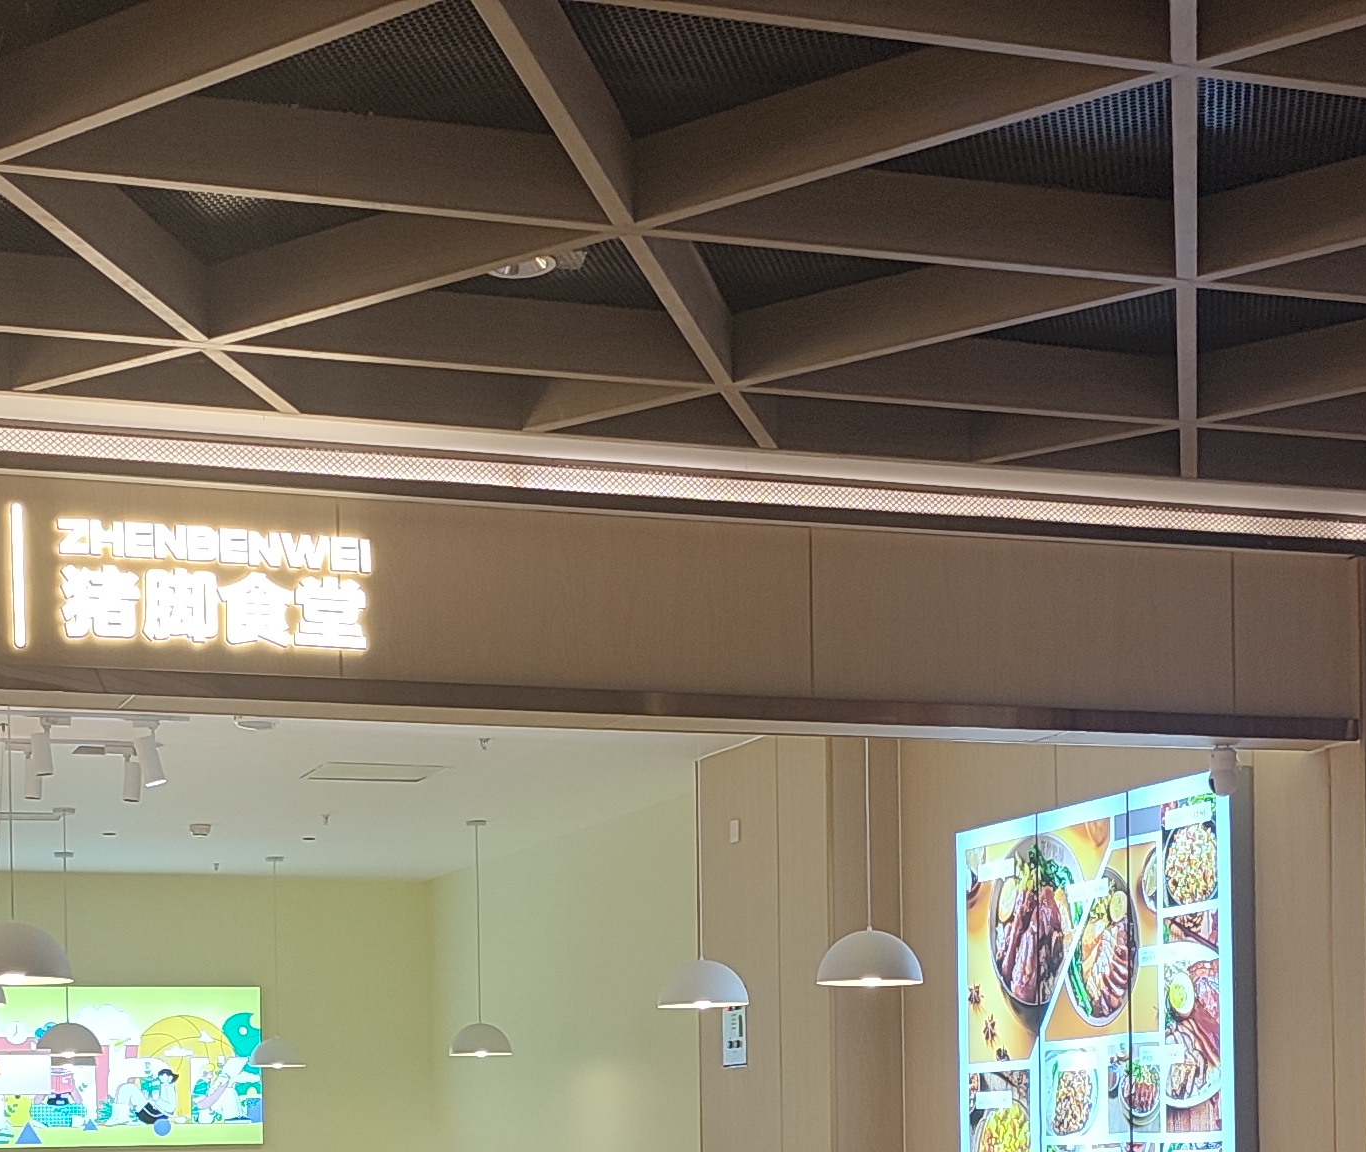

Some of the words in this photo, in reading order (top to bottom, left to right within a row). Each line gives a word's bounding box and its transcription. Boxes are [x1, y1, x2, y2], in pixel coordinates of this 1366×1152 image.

[56, 517, 372, 574] ZHENBENWEI
[59, 563, 368, 651] 猪脚食堂
